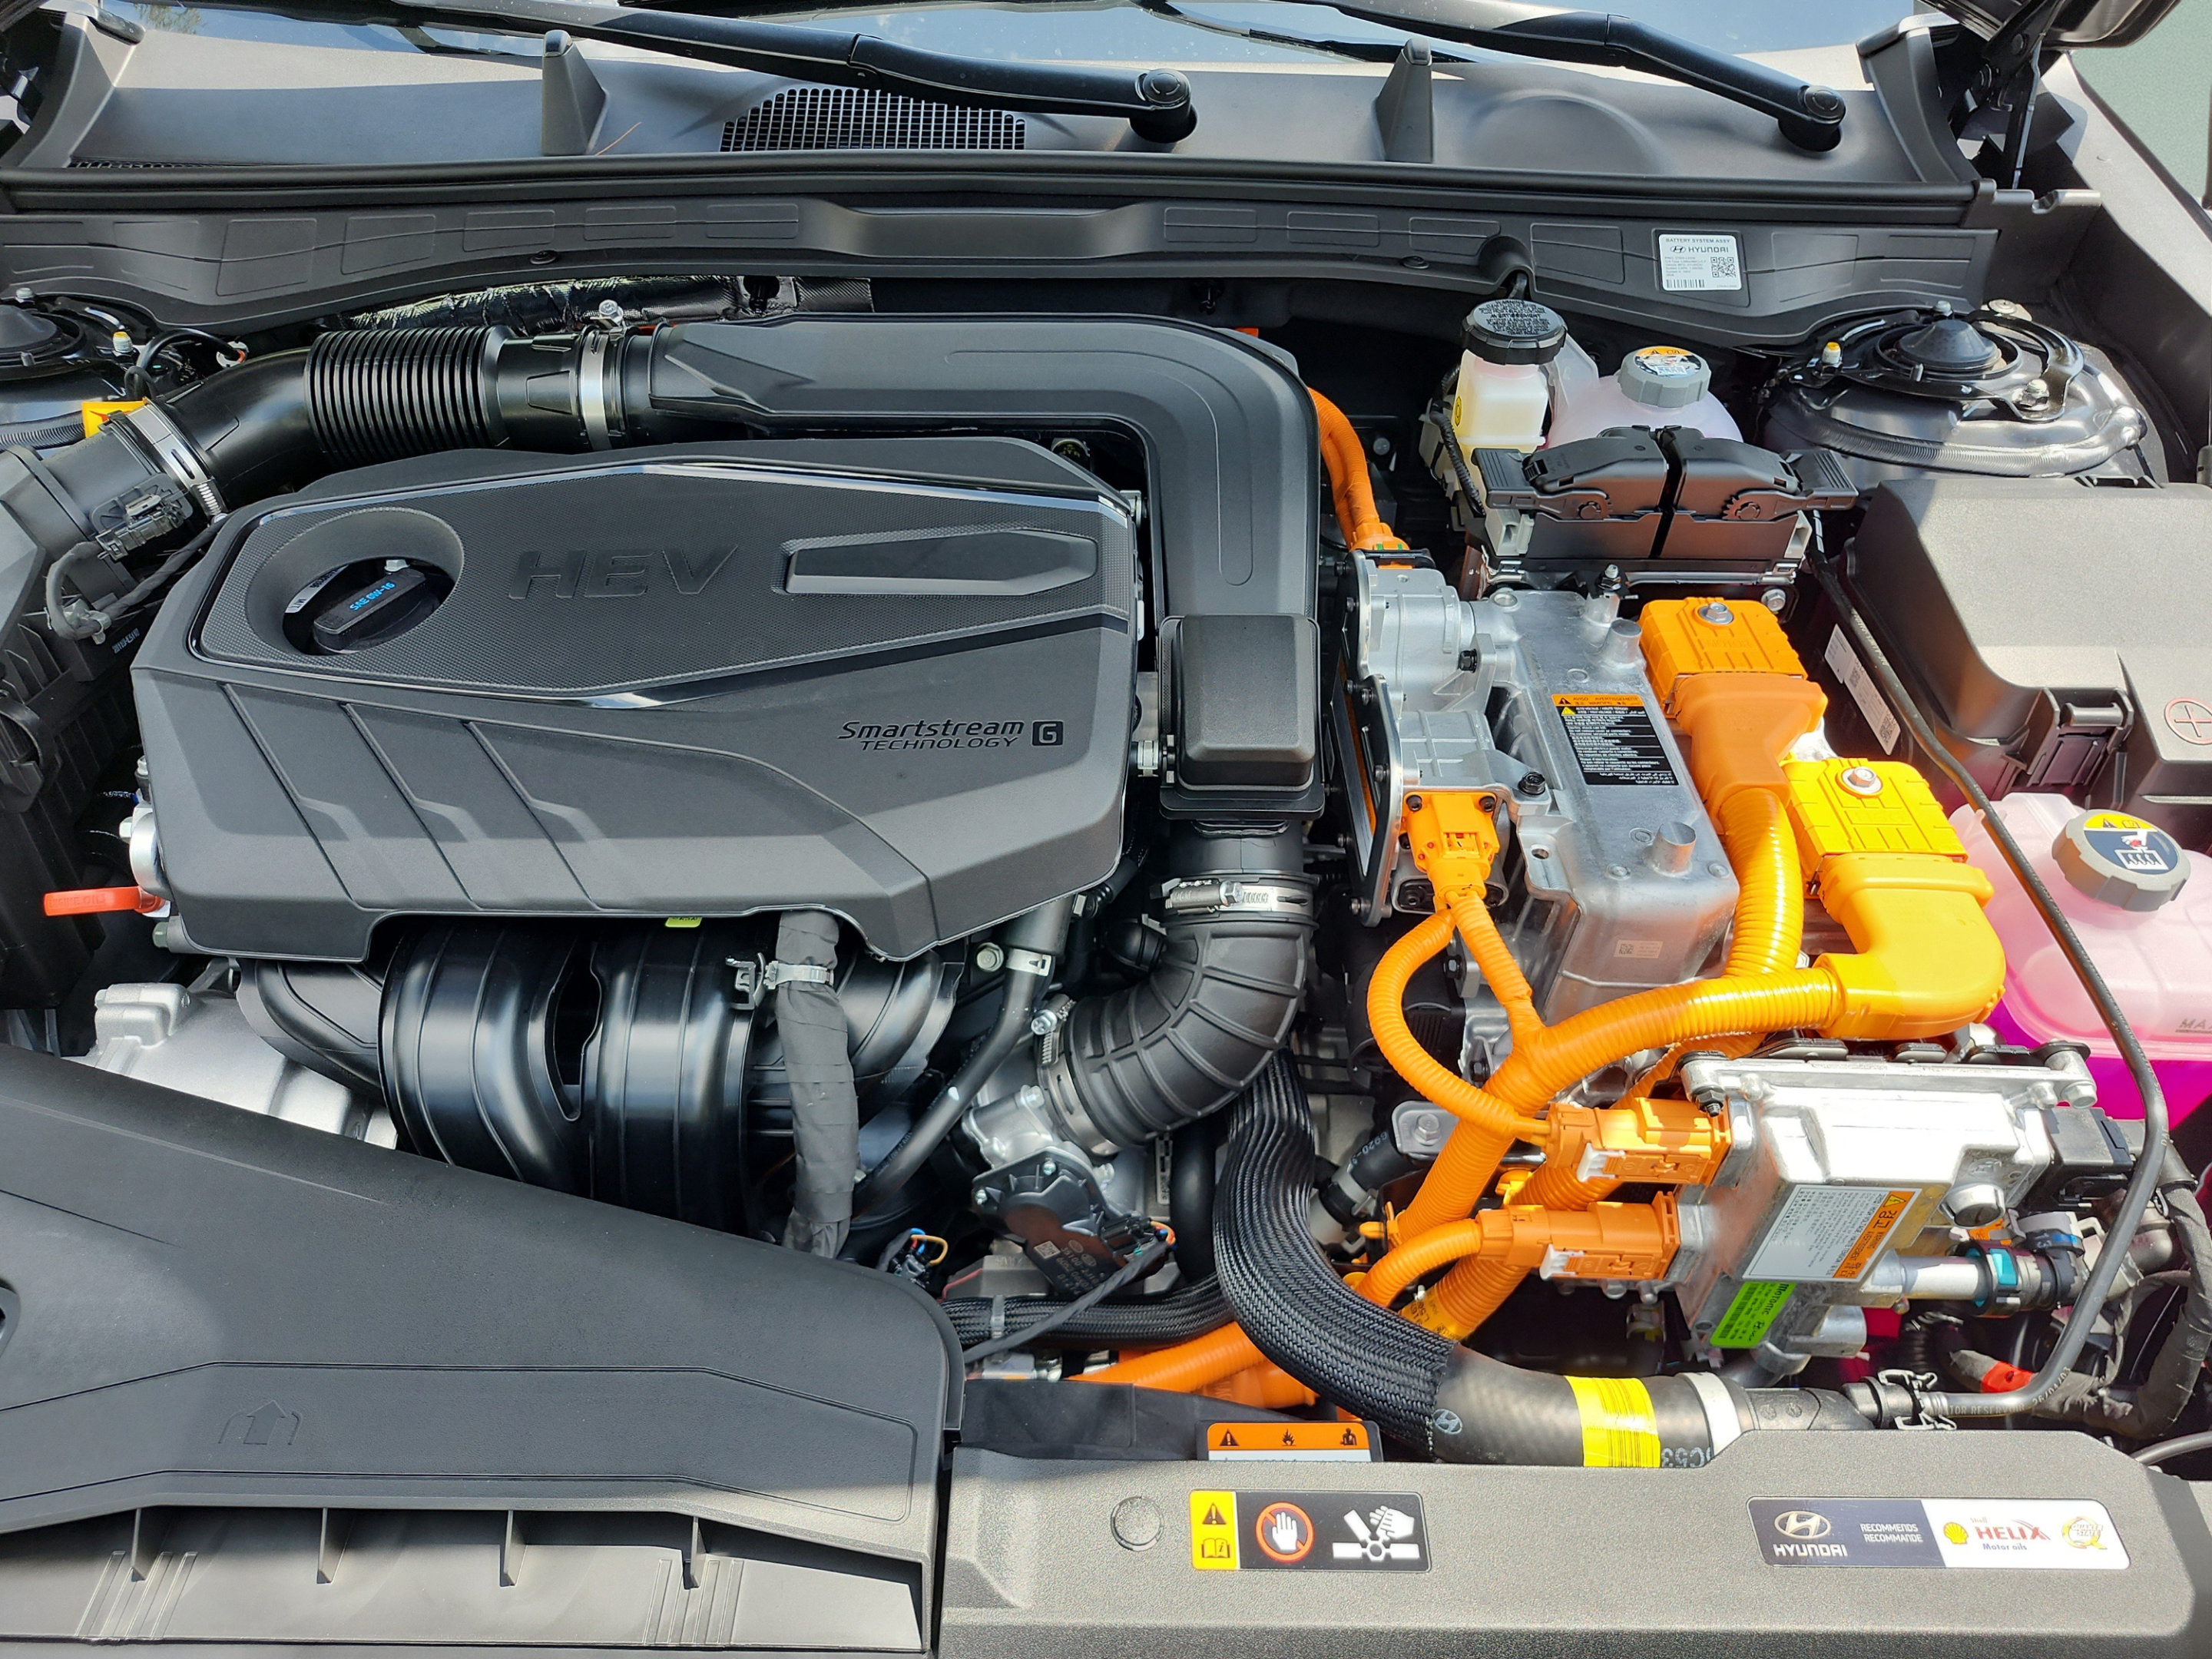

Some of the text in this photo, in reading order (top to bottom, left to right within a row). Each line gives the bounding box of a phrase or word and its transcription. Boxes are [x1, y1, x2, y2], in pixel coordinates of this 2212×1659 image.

[508, 545, 739, 599] HEV
[349, 581, 396, 611] SAE 0W-16
[837, 719, 1059, 745] Smartstream G
[859, 737, 1018, 750] TECHNOLOGY
[83, 894, 106, 905] OIL
[2178, 1018, 2212, 1030] MA
[1971, 1403, 2025, 1416] RESERVOIR
[1860, 1523, 1919, 1533] RECOMMENDS
[1975, 1526, 2048, 1541] HELIX
[1863, 1534, 1923, 1543] RECOMMANDE
[1773, 1544, 1848, 1557] HYUNDAI
